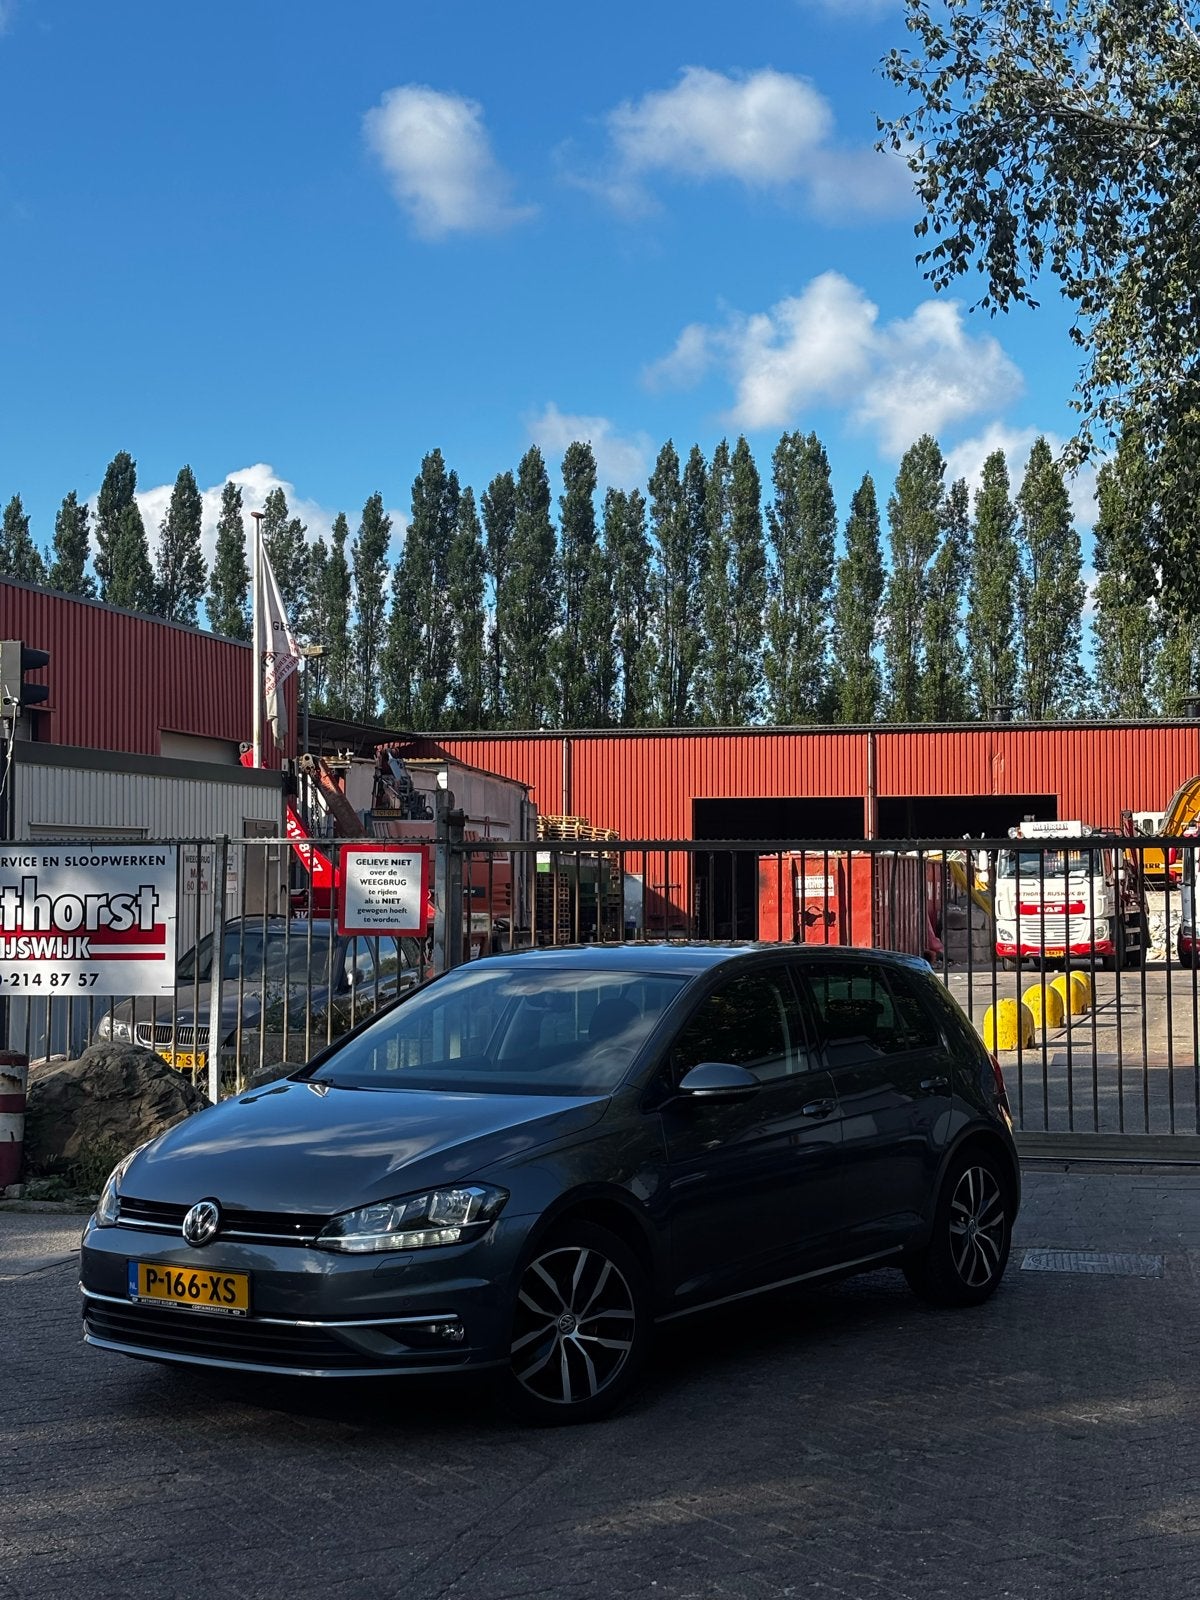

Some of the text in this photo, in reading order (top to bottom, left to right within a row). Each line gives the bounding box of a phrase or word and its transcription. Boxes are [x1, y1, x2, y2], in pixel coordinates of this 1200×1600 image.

[1, 855, 166, 867] RVICE EN SLOOPWERKEN
[356, 858, 389, 866] GELIEVE
[186, 881, 194, 891] 60
[359, 878, 407, 886] WEEGBRUG
[377, 888, 398, 897] rijden
[389, 907, 407, 915] hoeft
[49, 973, 71, 987] 87
[77, 973, 100, 987] 57
[129, 1281, 138, 1290] NL
[146, 1268, 236, 1304] P-166-XS
